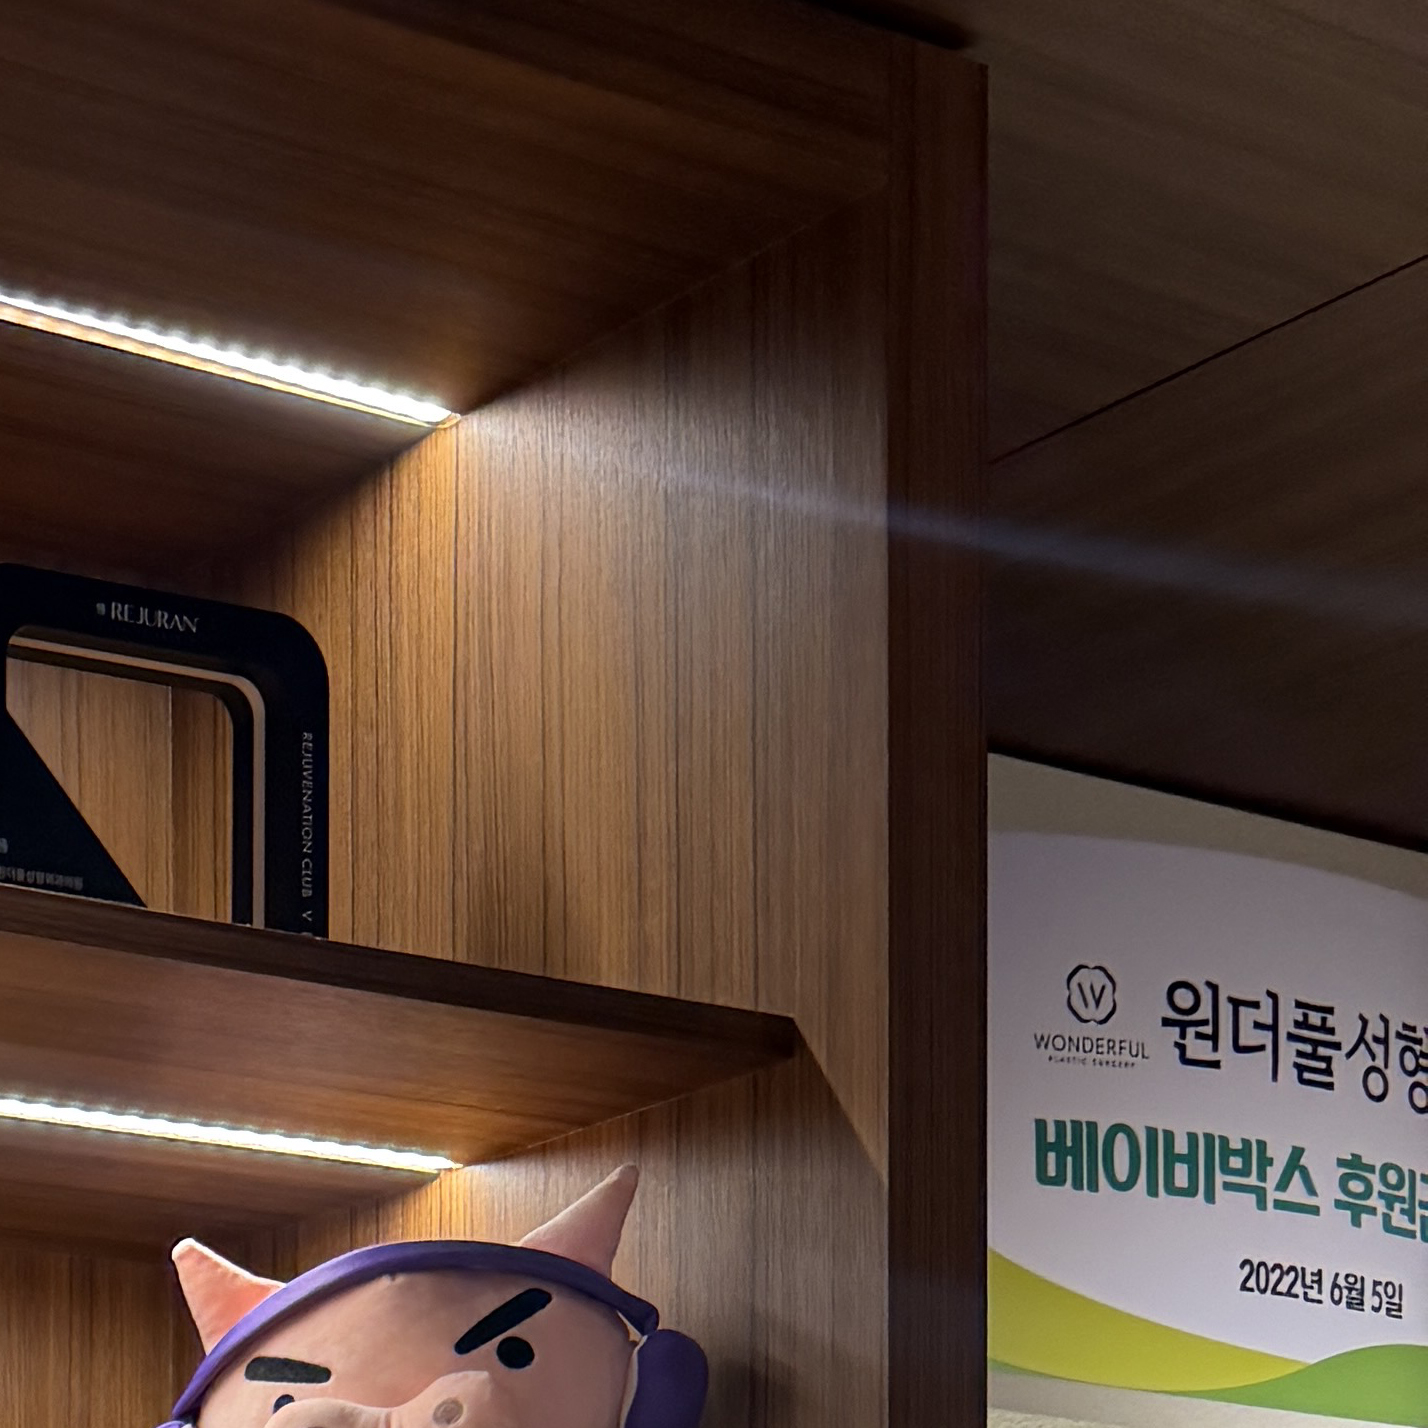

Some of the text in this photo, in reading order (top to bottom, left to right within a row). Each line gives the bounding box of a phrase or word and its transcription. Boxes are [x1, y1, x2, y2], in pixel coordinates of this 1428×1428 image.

[110, 601, 200, 633] REJURAN
[301, 731, 314, 898] REJUVENATION CLUB
[1034, 1033, 1150, 1060] WONDERFUL
[1034, 1118, 1428, 1245] 베이비박스 후원
[1238, 1258, 1404, 1319] 2022년 6월 5일
